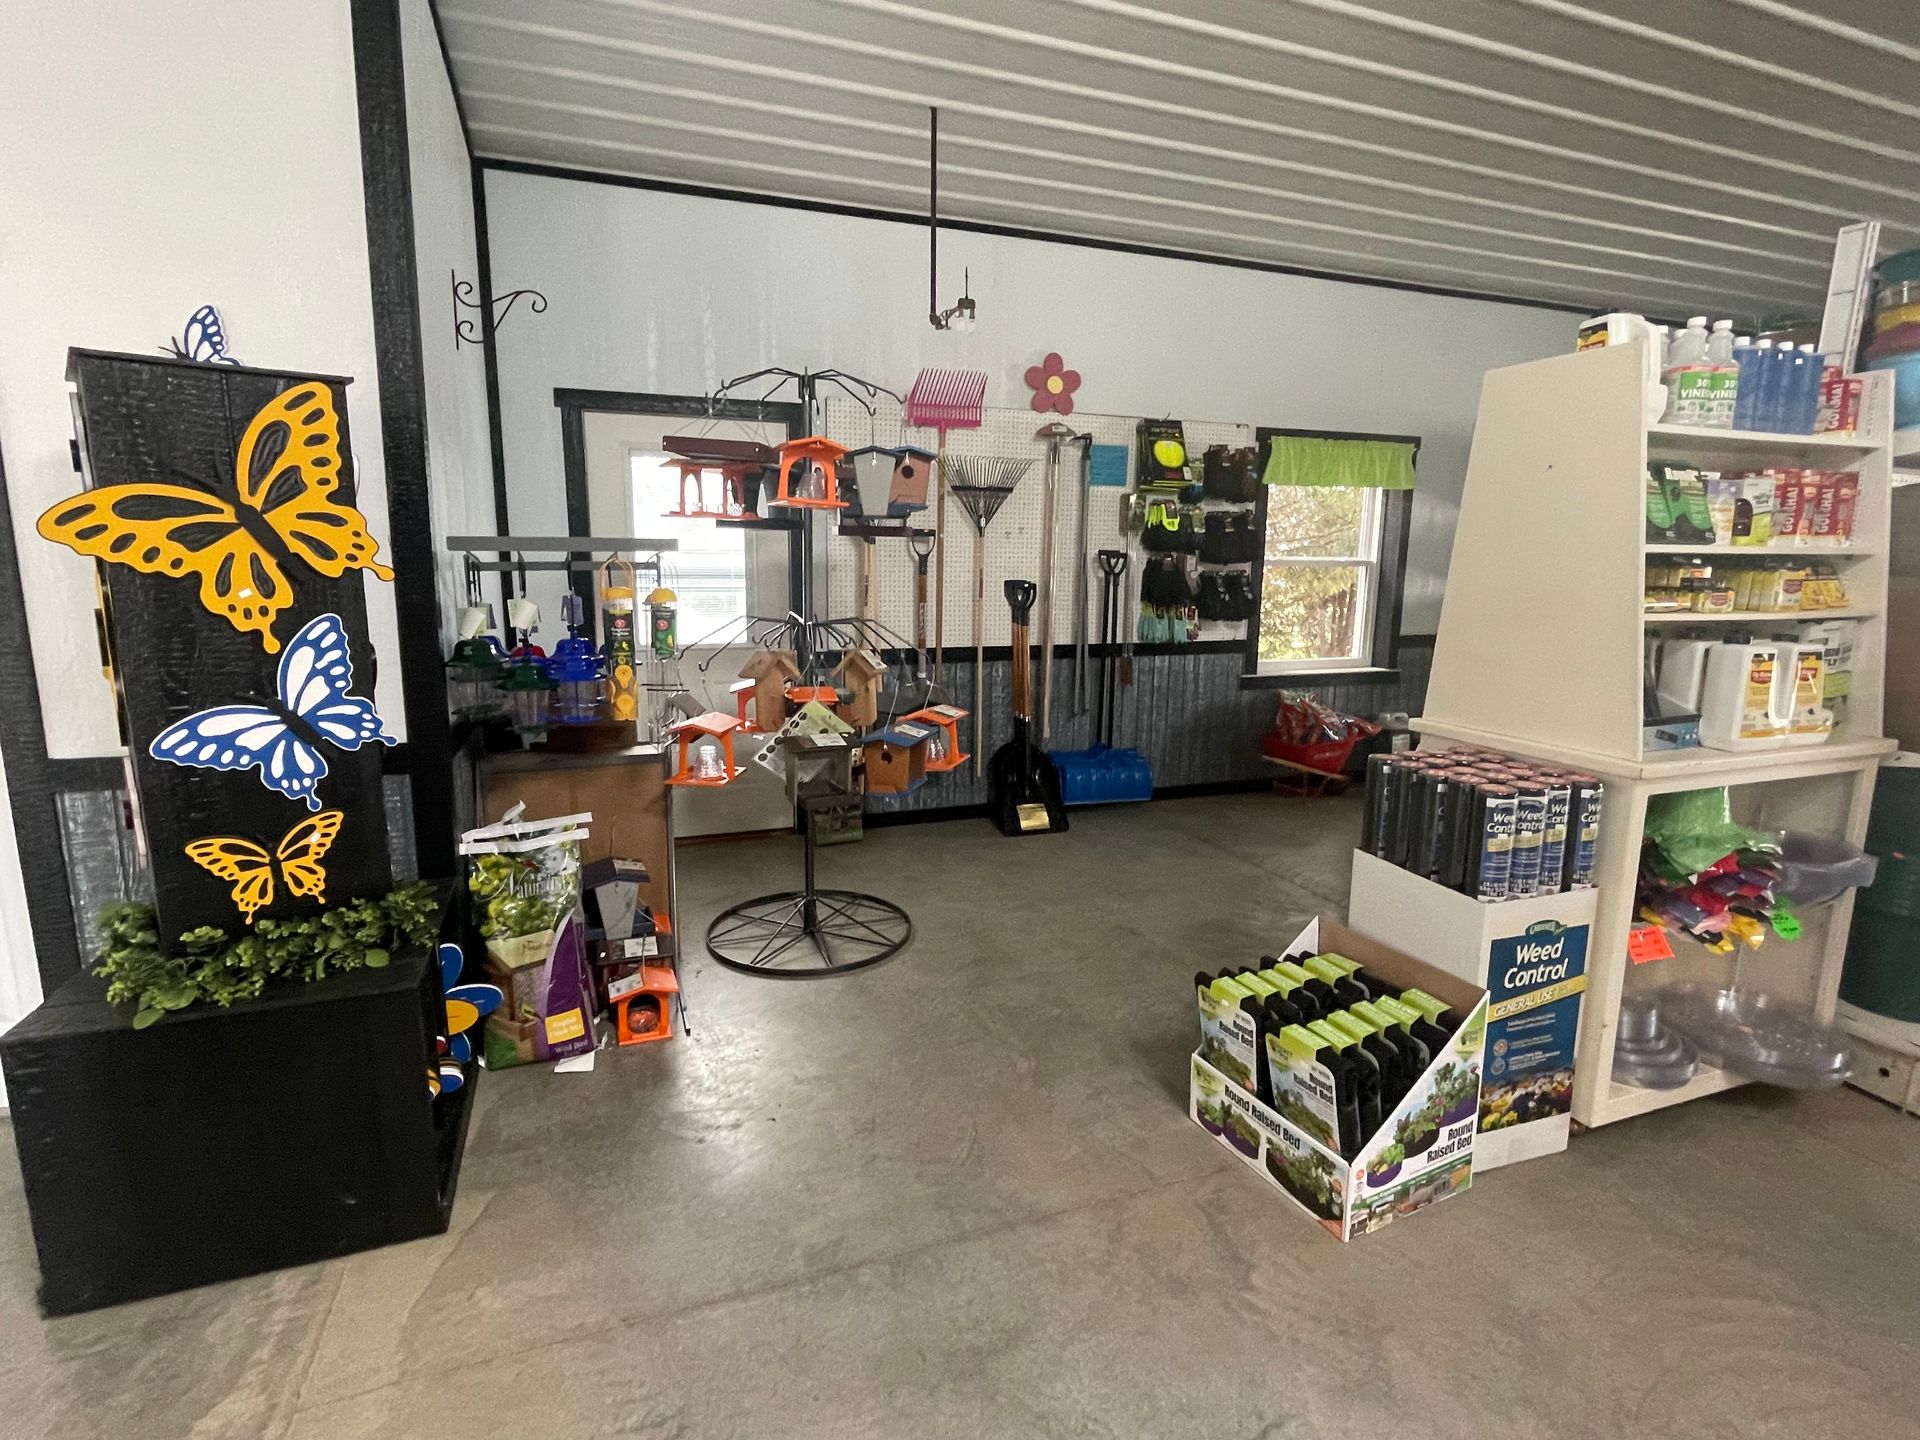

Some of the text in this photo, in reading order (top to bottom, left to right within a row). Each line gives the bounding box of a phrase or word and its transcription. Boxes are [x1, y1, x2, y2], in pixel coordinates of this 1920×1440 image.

[1516, 936, 1564, 966] Weed
[1503, 957, 1569, 989] Control
[1494, 988, 1555, 1018] GENERAL USE
[1224, 1084, 1301, 1150] Round Raised Bed
[1447, 1119, 1474, 1142] Round
[1426, 1133, 1472, 1164] Raised Bed
